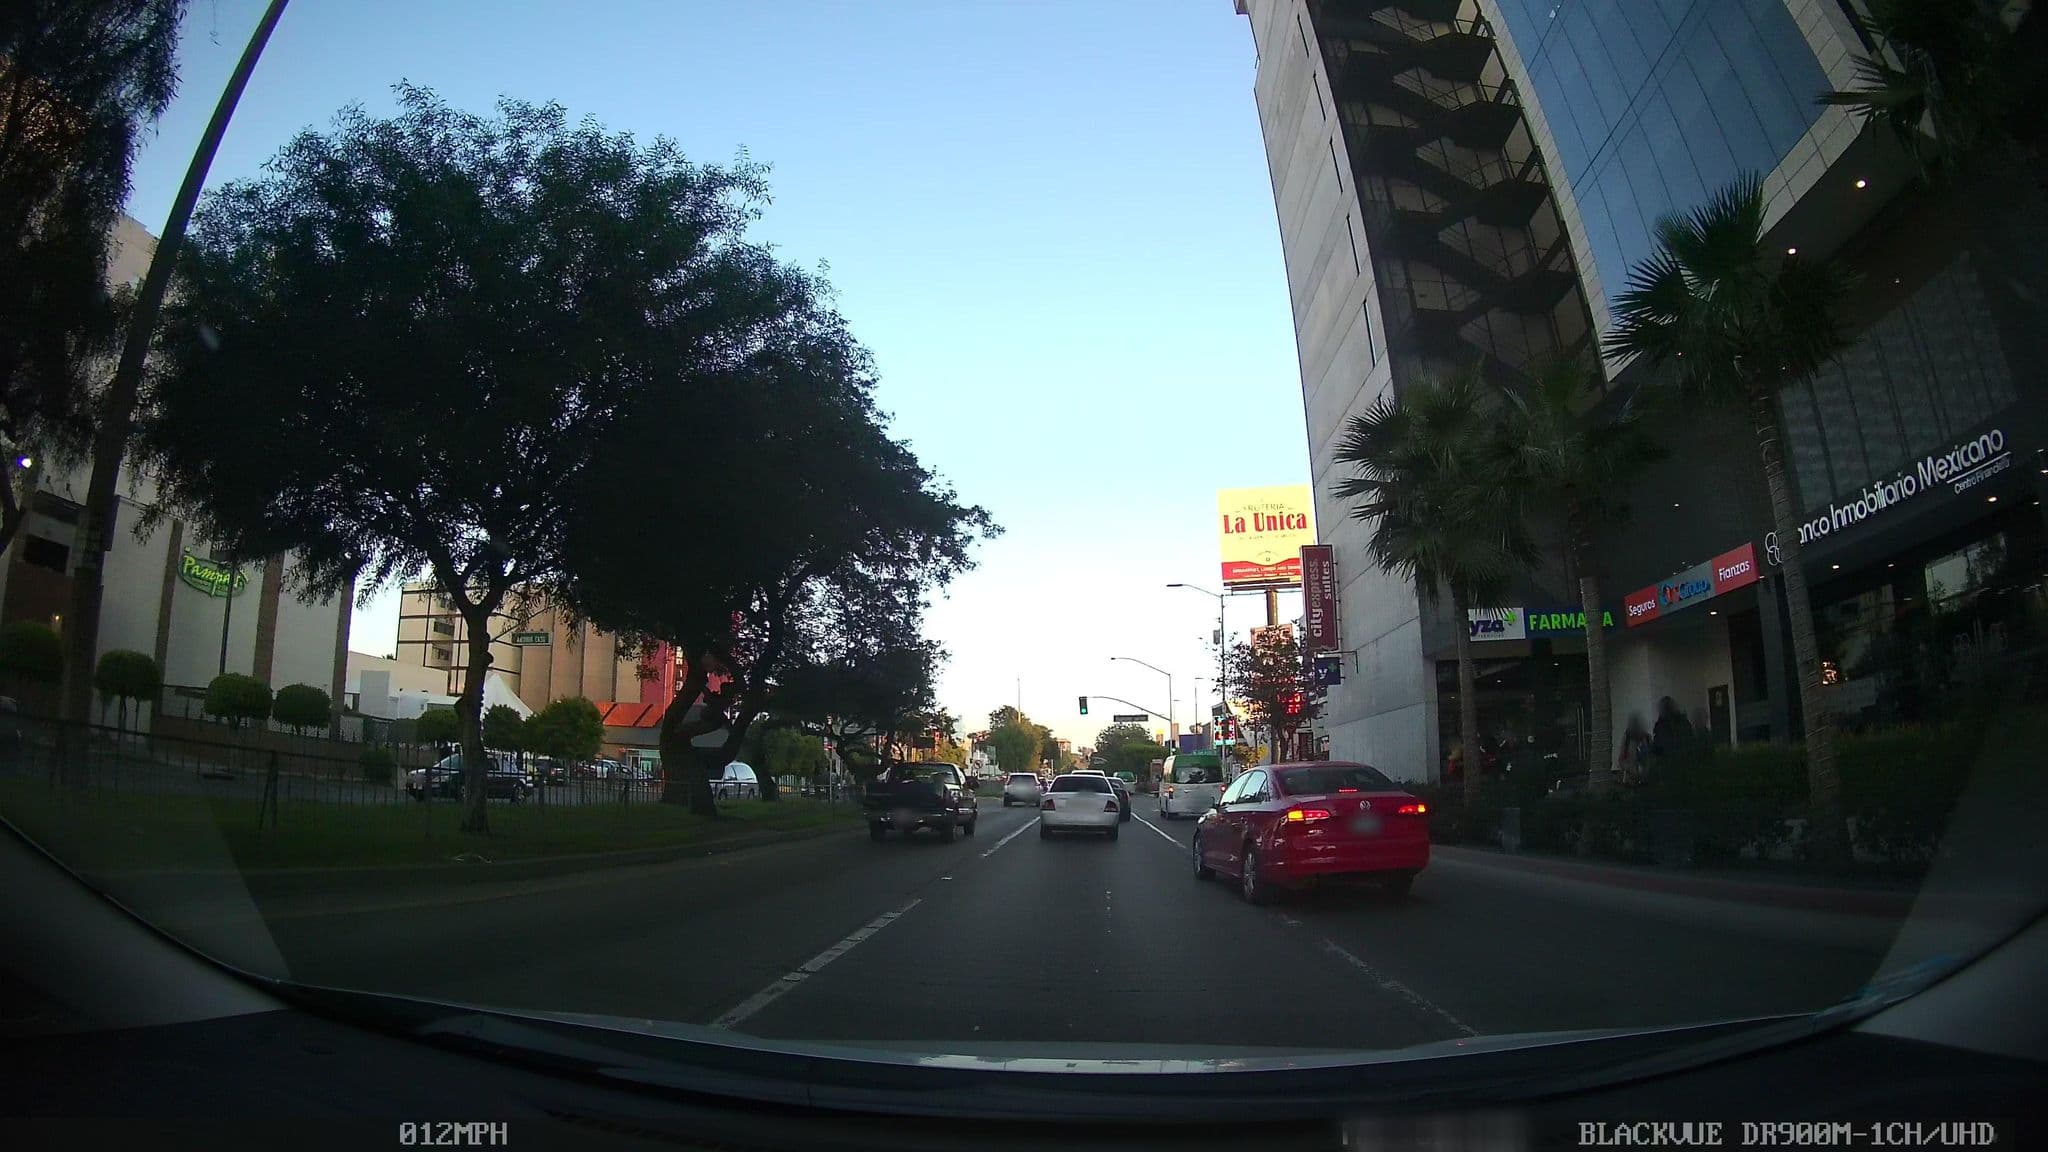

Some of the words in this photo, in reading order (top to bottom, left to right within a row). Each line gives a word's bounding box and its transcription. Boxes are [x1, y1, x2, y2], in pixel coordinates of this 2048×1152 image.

[1797, 514, 1831, 544] anco
[1830, 472, 1917, 532] Inmobiliario
[1917, 429, 2005, 493] Mexicano
[1223, 514, 1246, 534] La
[1253, 511, 1307, 532] Unica
[1719, 560, 1750, 582] Fianzas
[1628, 599, 1656, 617] Seguros
[1529, 611, 1614, 632] FARMAA
